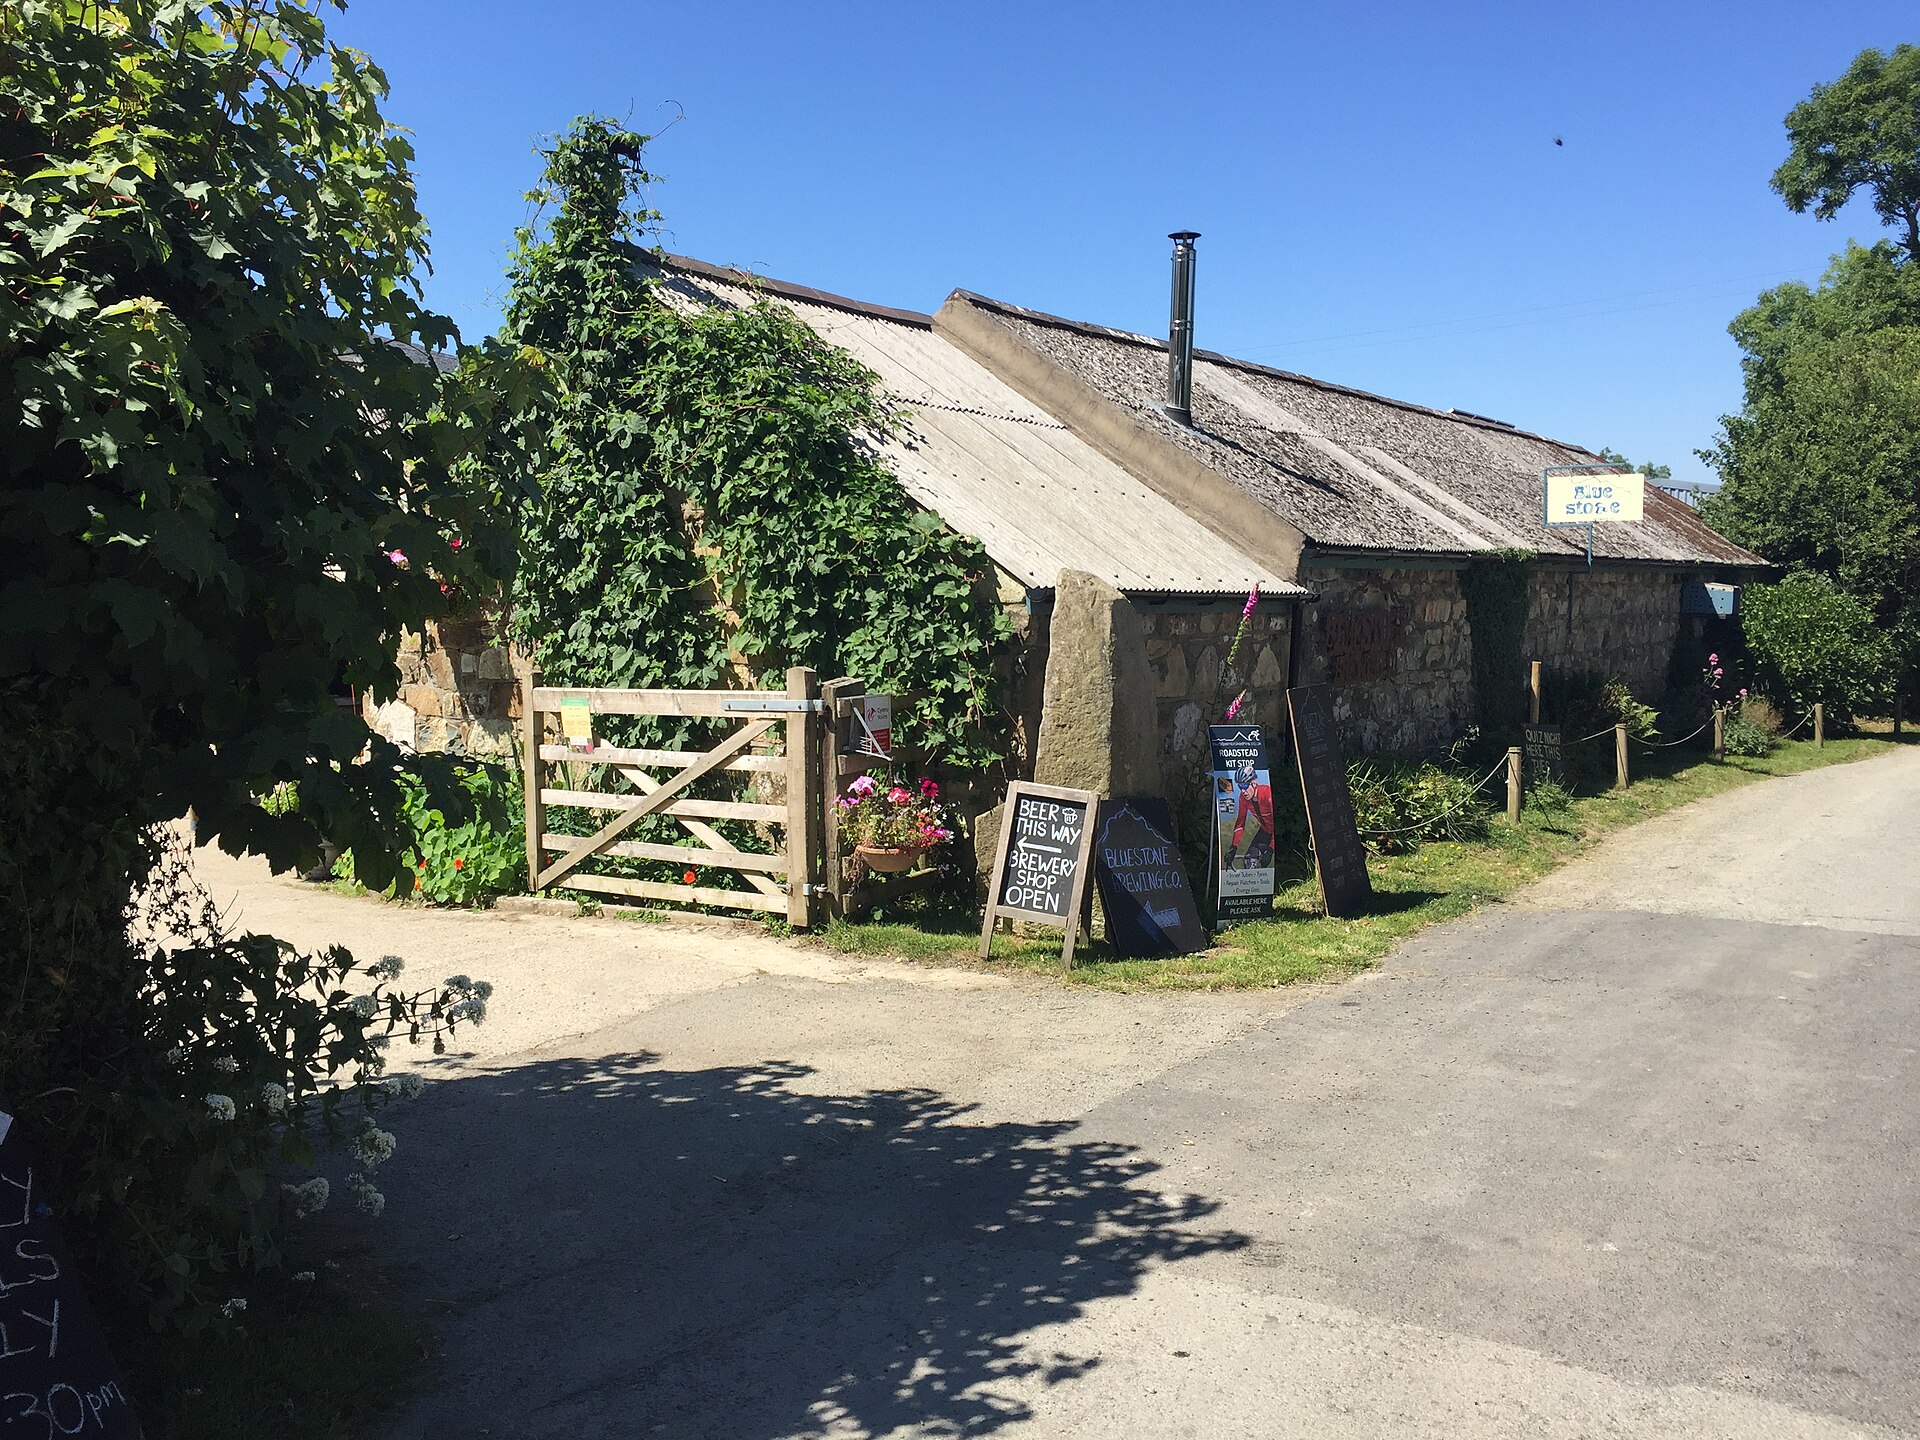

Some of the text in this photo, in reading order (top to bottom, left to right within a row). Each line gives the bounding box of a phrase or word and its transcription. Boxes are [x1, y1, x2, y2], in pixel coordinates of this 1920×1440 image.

[1574, 485, 1613, 499] Blue
[1525, 729, 1561, 745] QUIZ NIGHT
[1219, 749, 1259, 757] ROADSTEAD
[1526, 743, 1562, 761] HERE THIS
[1225, 759, 1255, 768] KIT STOP
[1019, 799, 1060, 822] BEER
[1016, 817, 1082, 846] THIS WAY
[1009, 849, 1078, 878] BREWERY
[1105, 846, 1171, 869] BLUESTONE
[1016, 869, 1057, 891] SHOP
[1112, 870, 1163, 894] BREWING
[1005, 886, 1060, 913] OPEN
[1224, 897, 1268, 906] AVAILABLE HERE
[1229, 906, 1262, 915] PLEASE ASK
